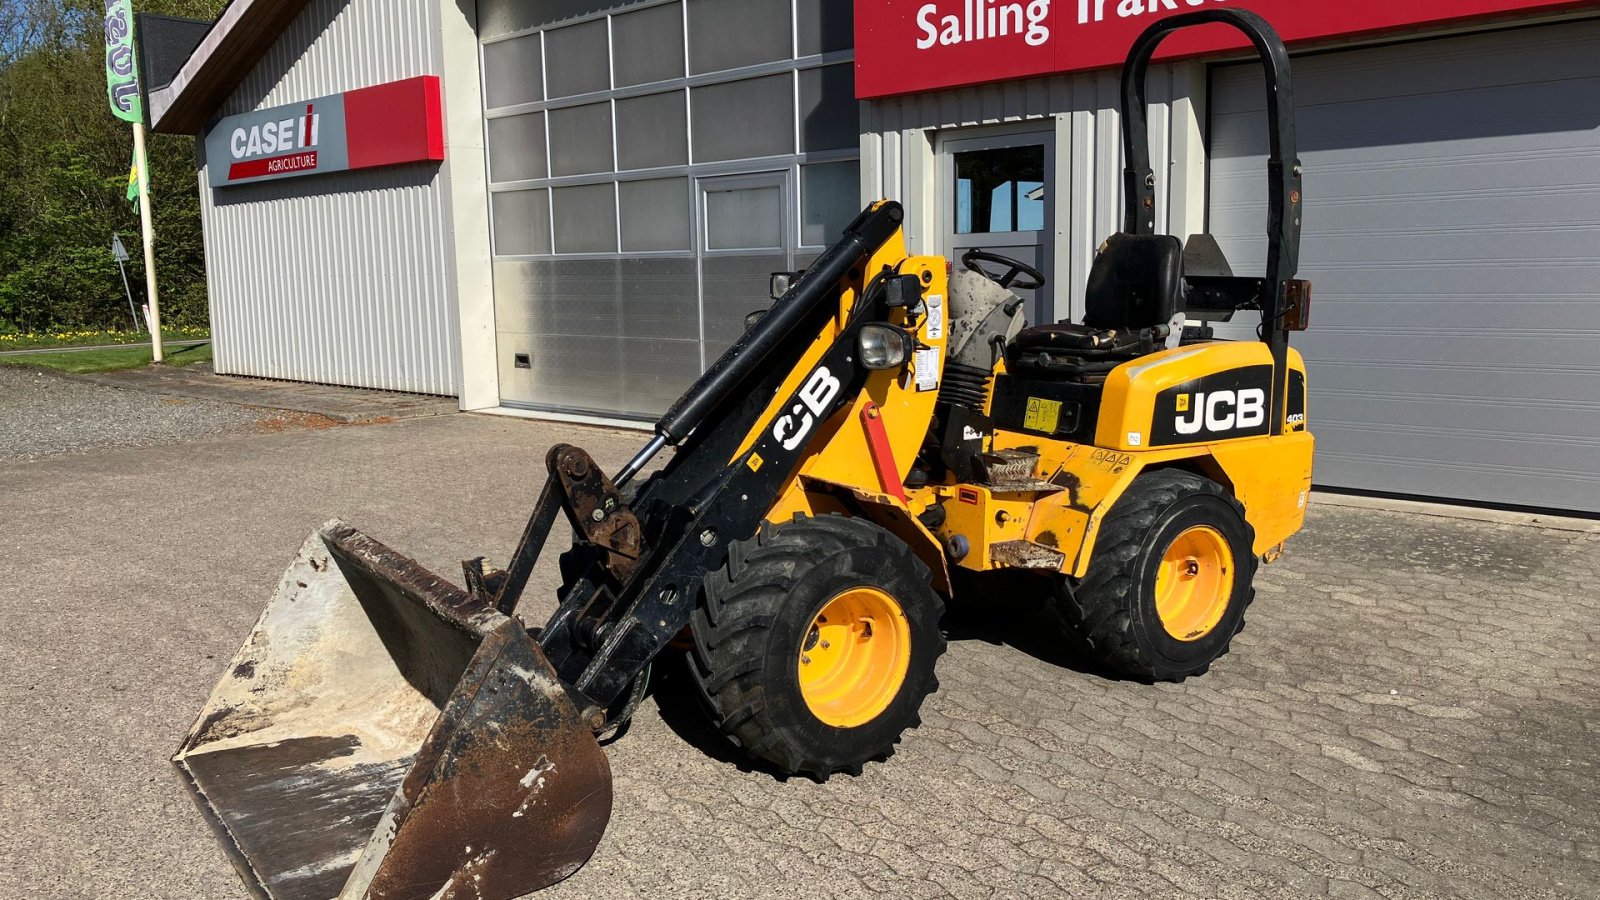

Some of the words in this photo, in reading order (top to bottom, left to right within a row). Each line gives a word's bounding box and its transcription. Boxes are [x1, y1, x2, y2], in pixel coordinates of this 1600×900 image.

[916, 0, 1050, 50] Salling
[230, 118, 294, 159] CASE
[268, 154, 315, 172] AGRICULTURE
[1174, 388, 1265, 434] JCB
[1286, 413, 1304, 424] 403
